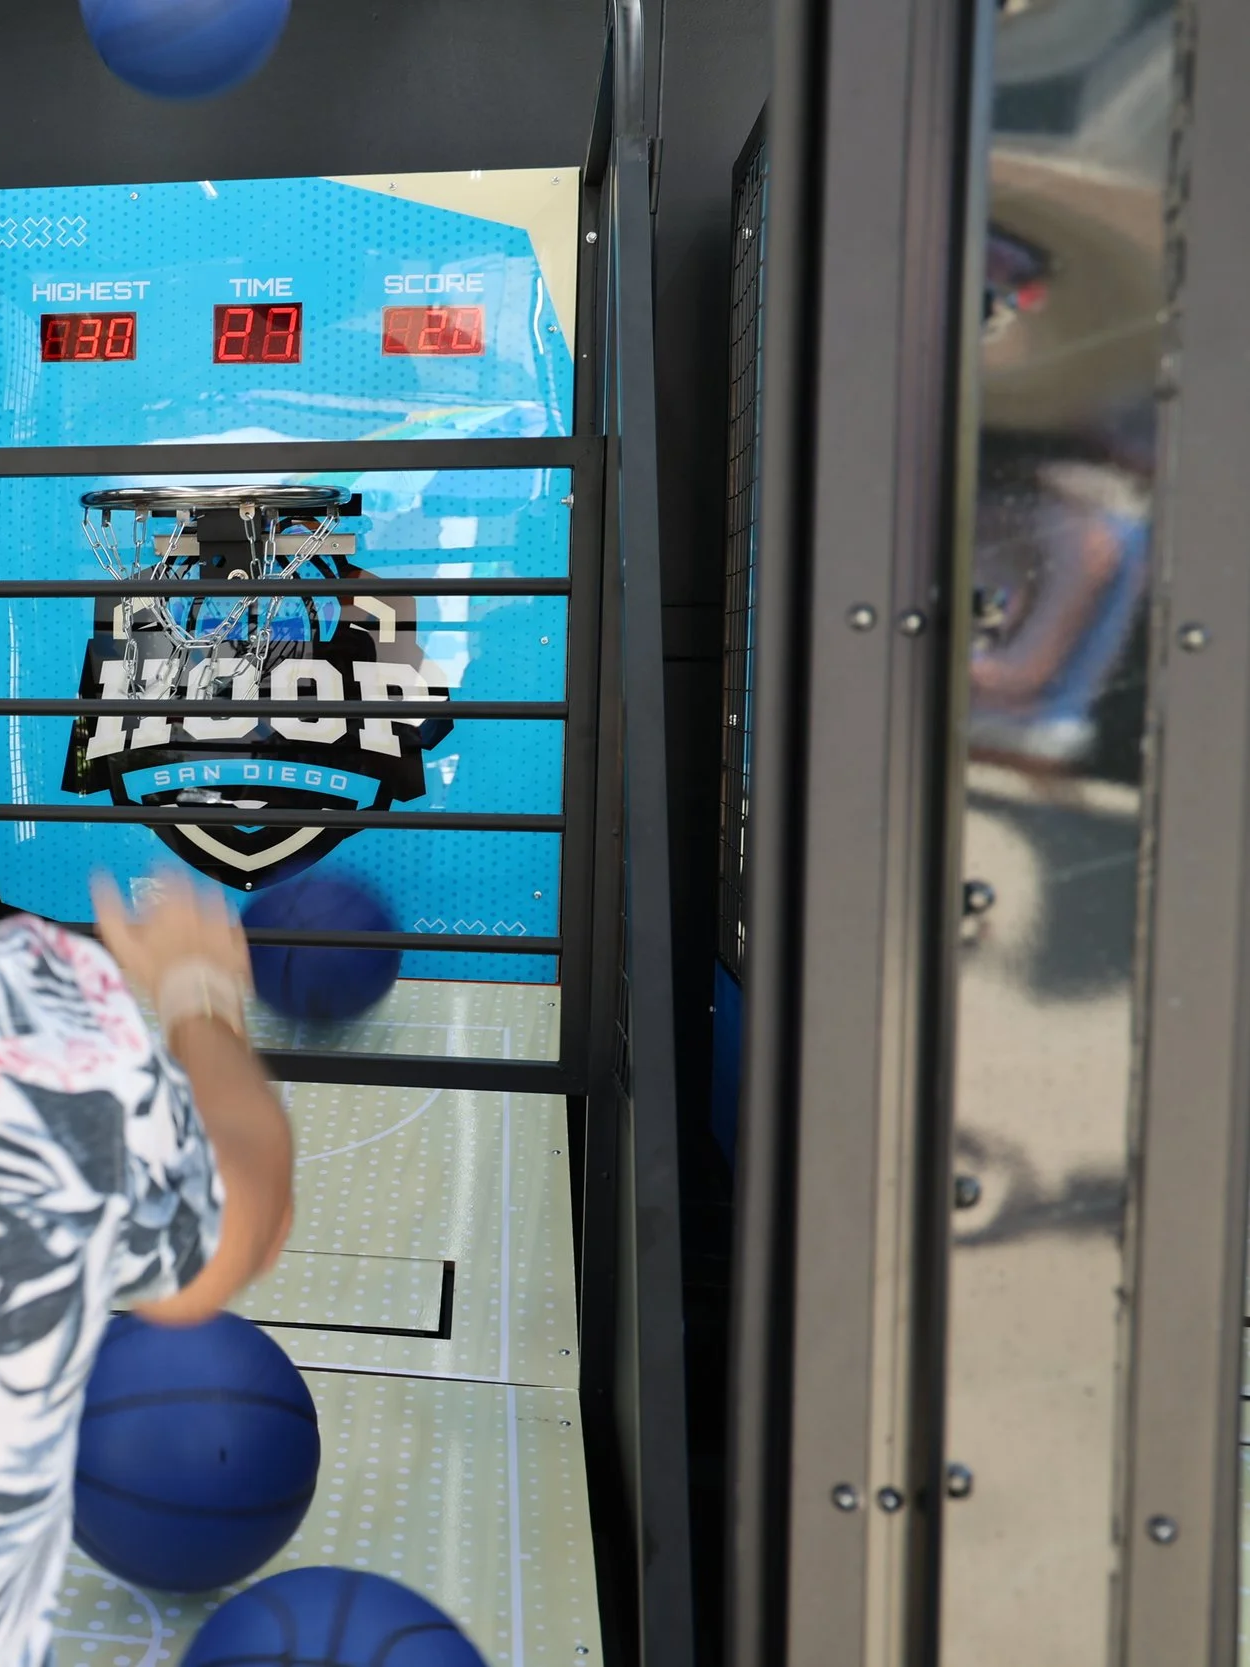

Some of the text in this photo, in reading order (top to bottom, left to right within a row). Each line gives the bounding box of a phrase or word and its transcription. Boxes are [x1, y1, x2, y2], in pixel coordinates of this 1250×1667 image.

[32, 280, 151, 302] HIGHEST
[229, 277, 293, 297] TIME
[384, 273, 484, 294] SCORE
[74, 317, 134, 359] 30
[218, 307, 298, 361] 27
[86, 657, 431, 761] HOOP
[154, 764, 348, 791] SAN DIEGO
